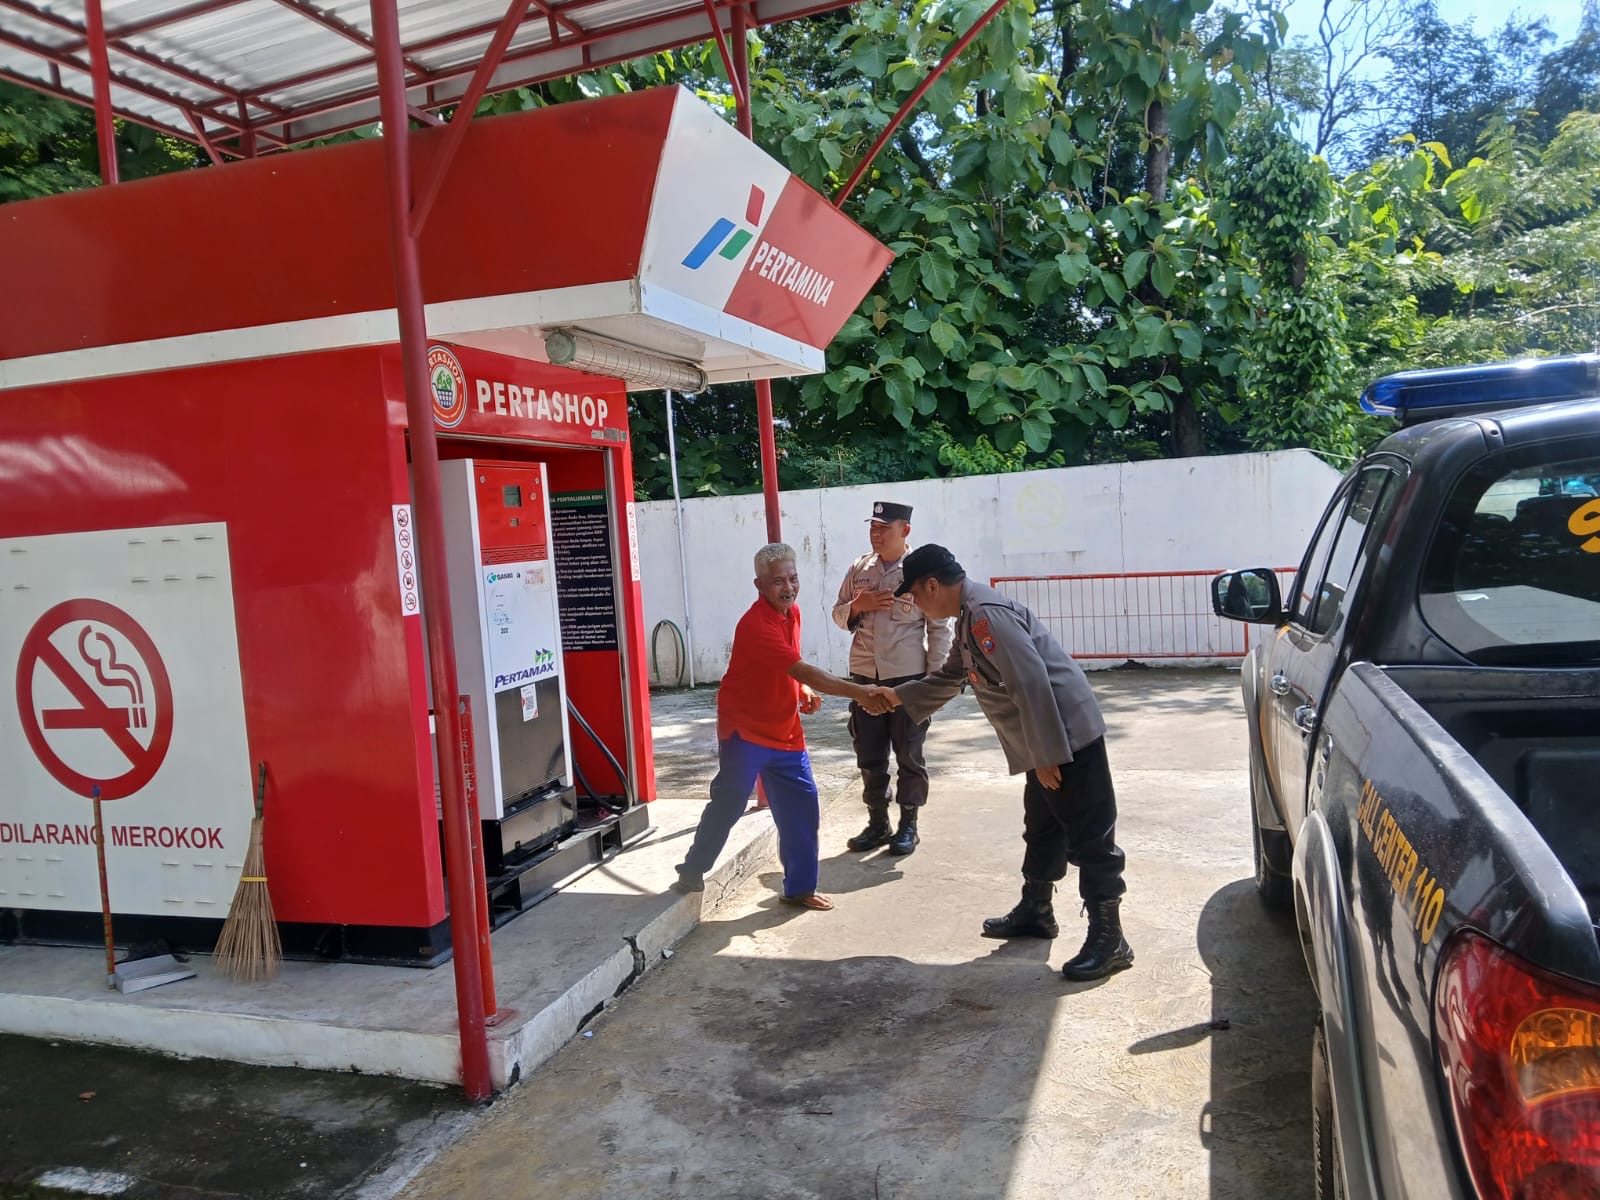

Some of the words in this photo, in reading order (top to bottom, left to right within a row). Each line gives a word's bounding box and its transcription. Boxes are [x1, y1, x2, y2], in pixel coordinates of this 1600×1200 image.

[749, 241, 835, 307] PERTAMINA
[428, 352, 462, 384] RTASHOP
[476, 379, 608, 427] PERTASHOP
[494, 662, 554, 688] PERTAMAX
[111, 826, 224, 849] MEROKOK
[1357, 779, 1382, 842] CALL
[1373, 808, 1419, 904] CENTER
[1410, 867, 1445, 945] 110
